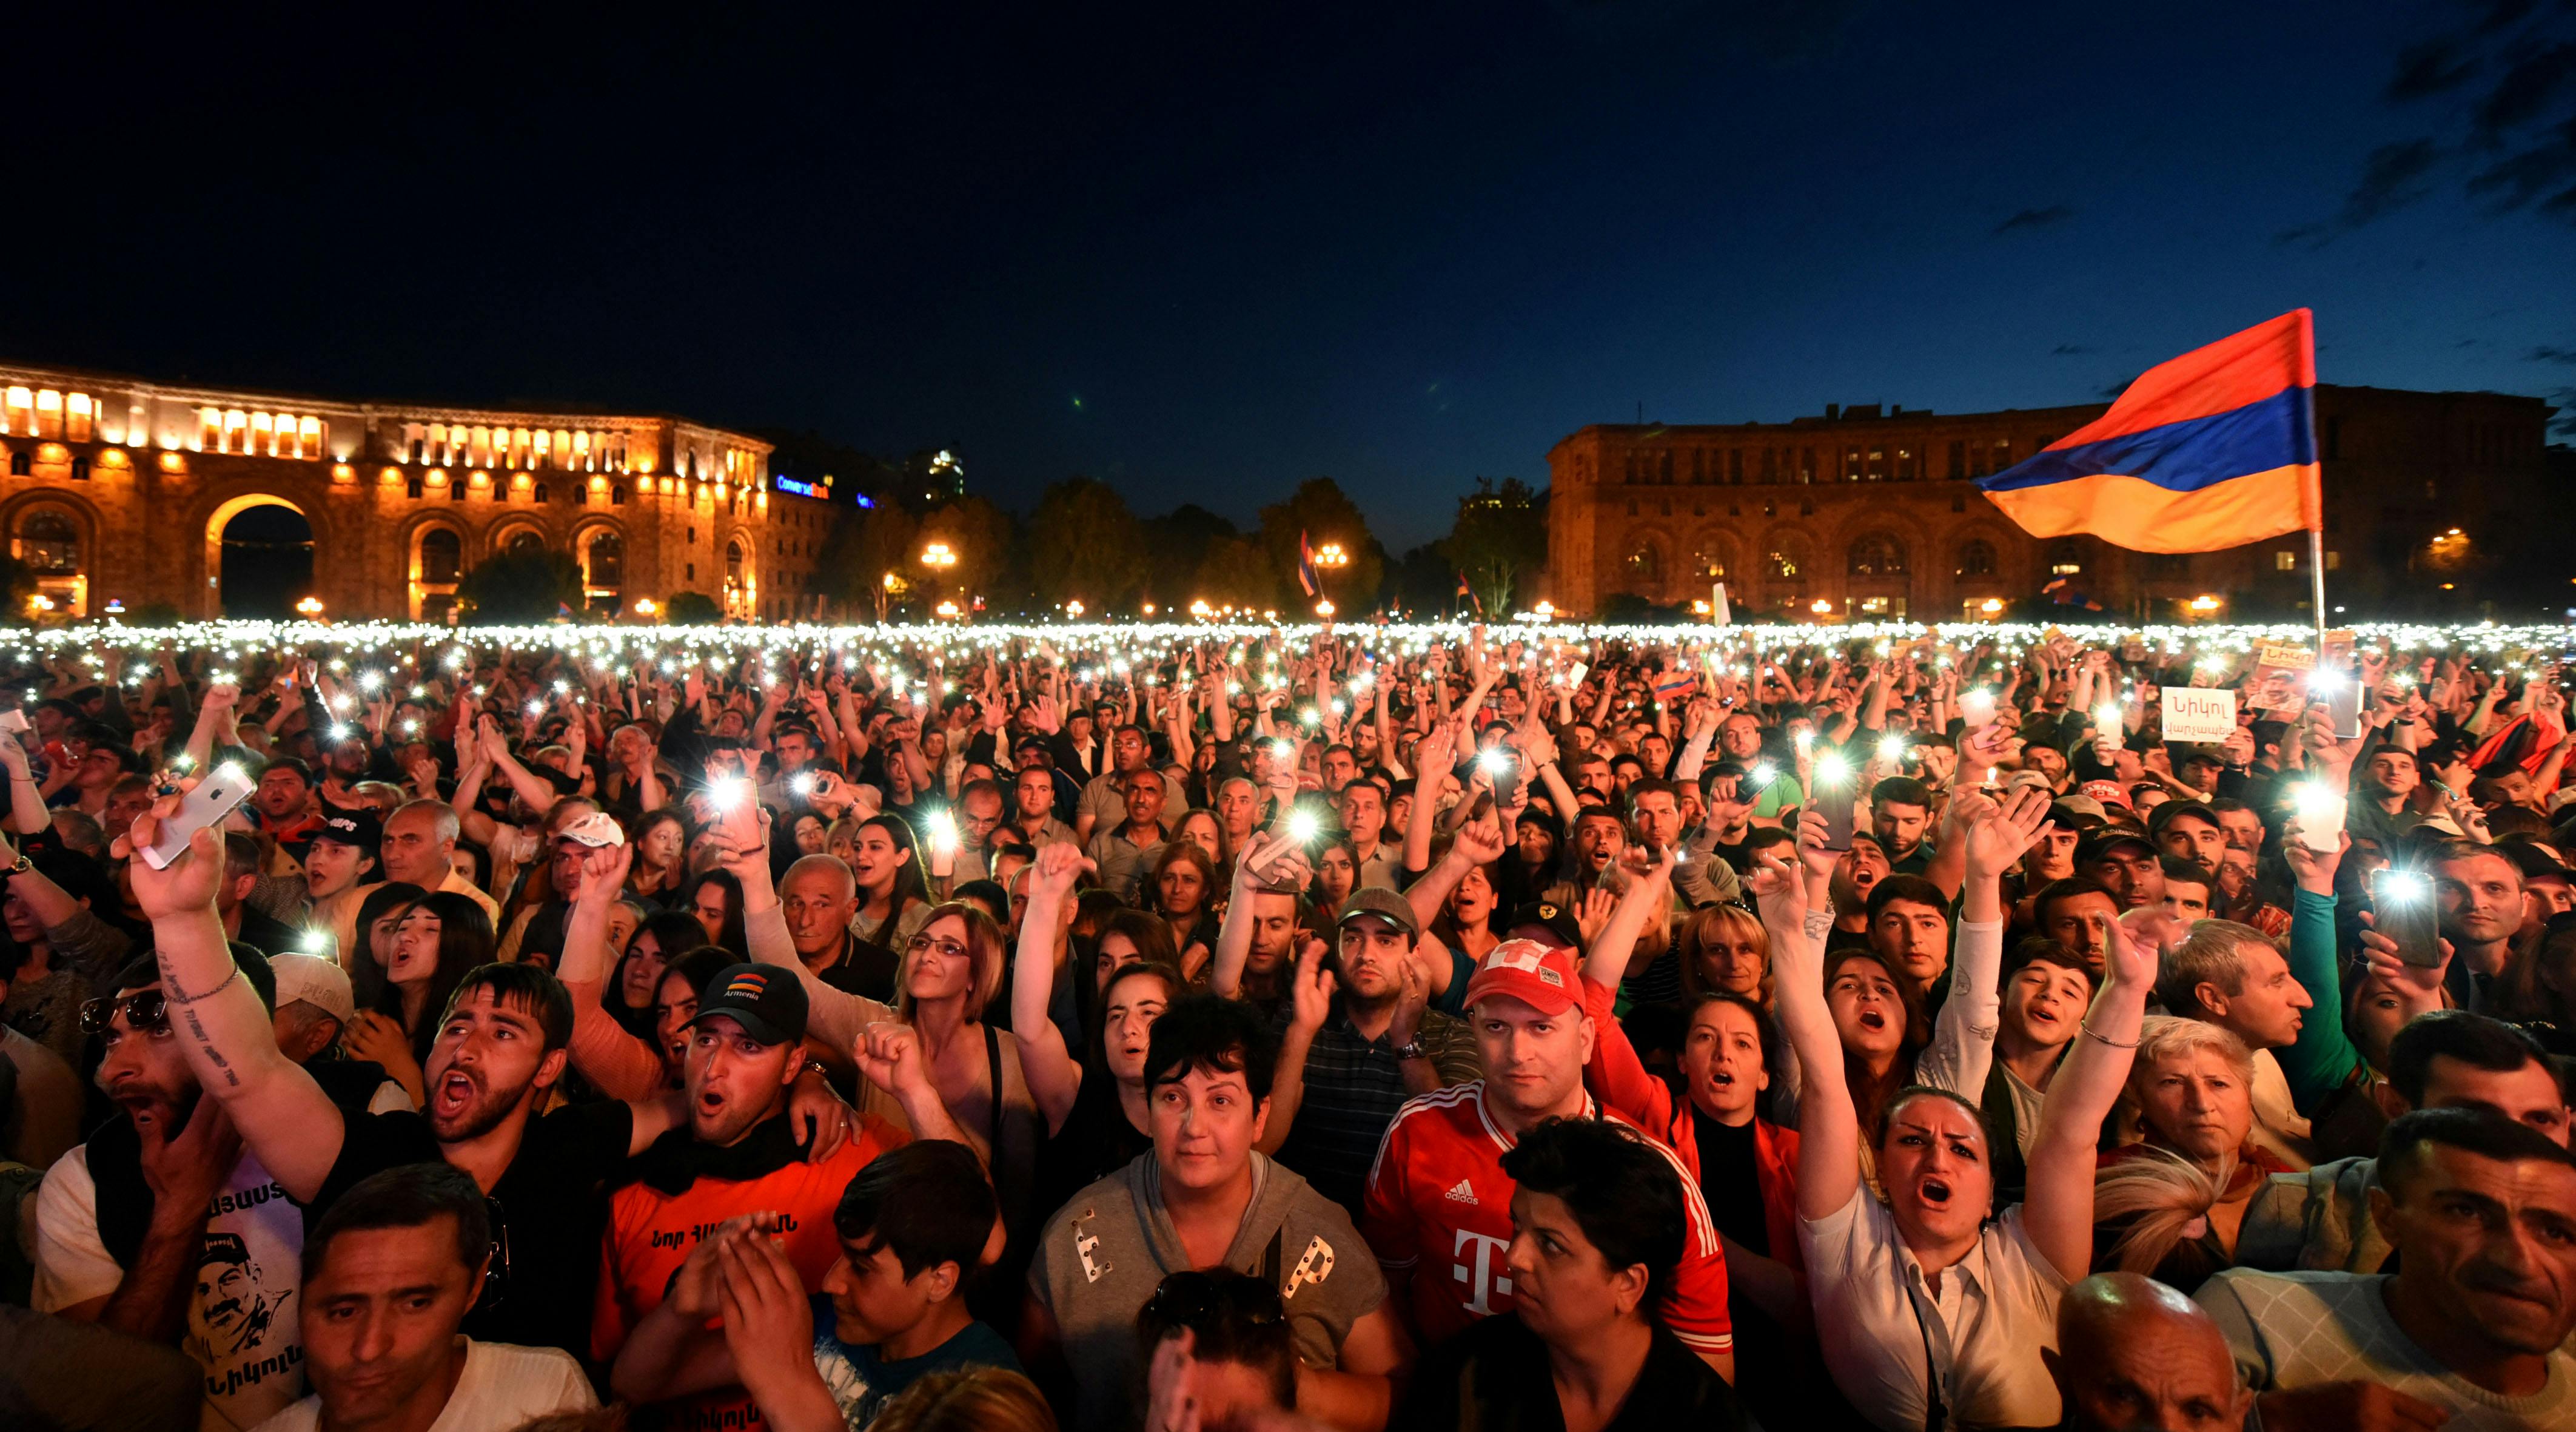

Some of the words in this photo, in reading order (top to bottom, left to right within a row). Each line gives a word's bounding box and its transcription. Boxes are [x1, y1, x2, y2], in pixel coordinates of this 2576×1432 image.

[2173, 696, 2229, 719] Նիկոլ
[723, 990, 759, 1001] Armenia
[1444, 1192, 1478, 1205] adidas
[1282, 1235, 1334, 1299] P
